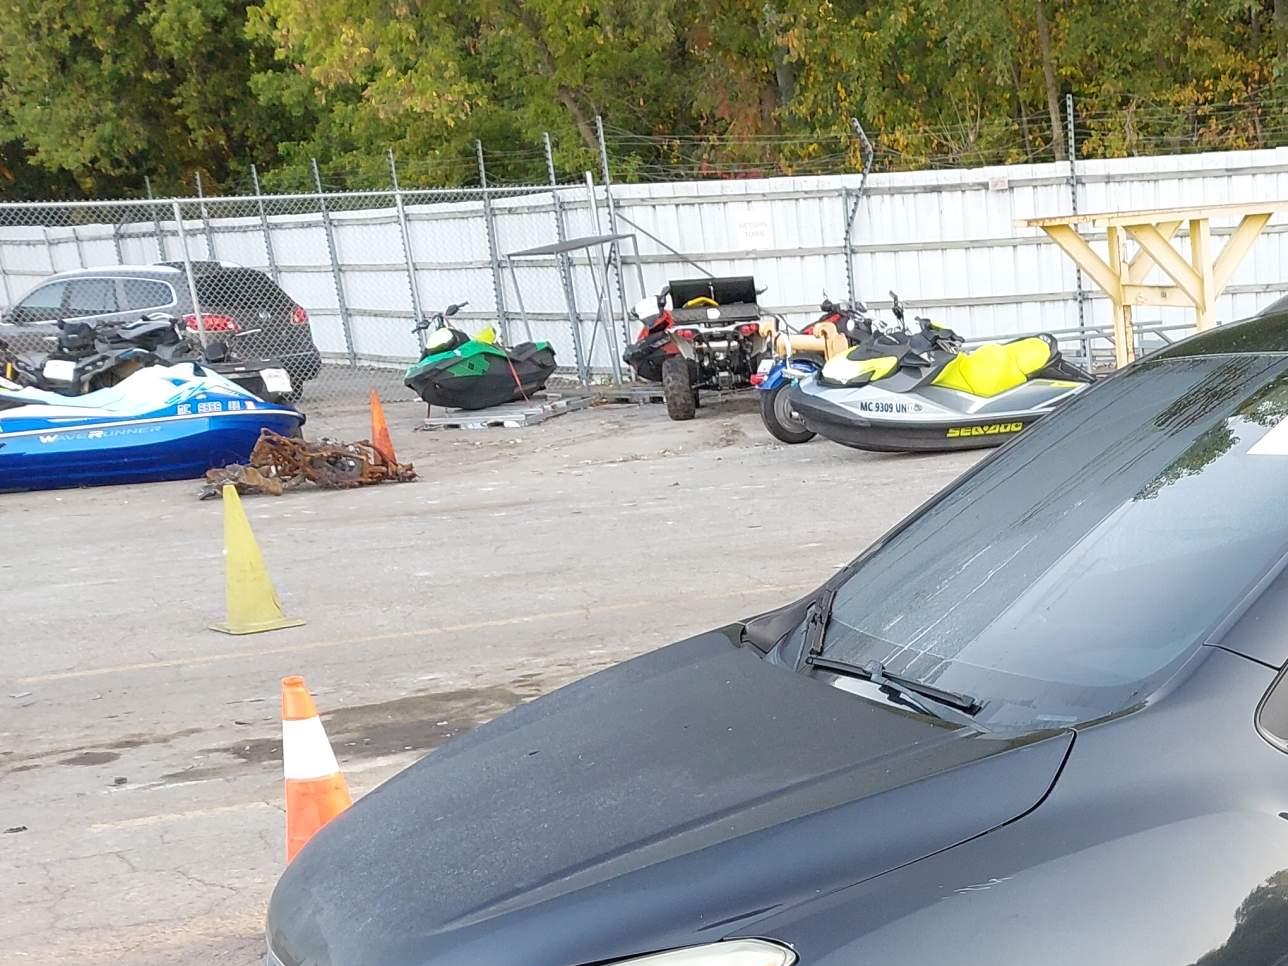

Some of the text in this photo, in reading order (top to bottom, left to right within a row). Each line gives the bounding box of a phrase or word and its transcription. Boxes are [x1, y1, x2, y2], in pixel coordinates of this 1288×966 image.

[860, 401, 907, 413] MC 9309 UN
